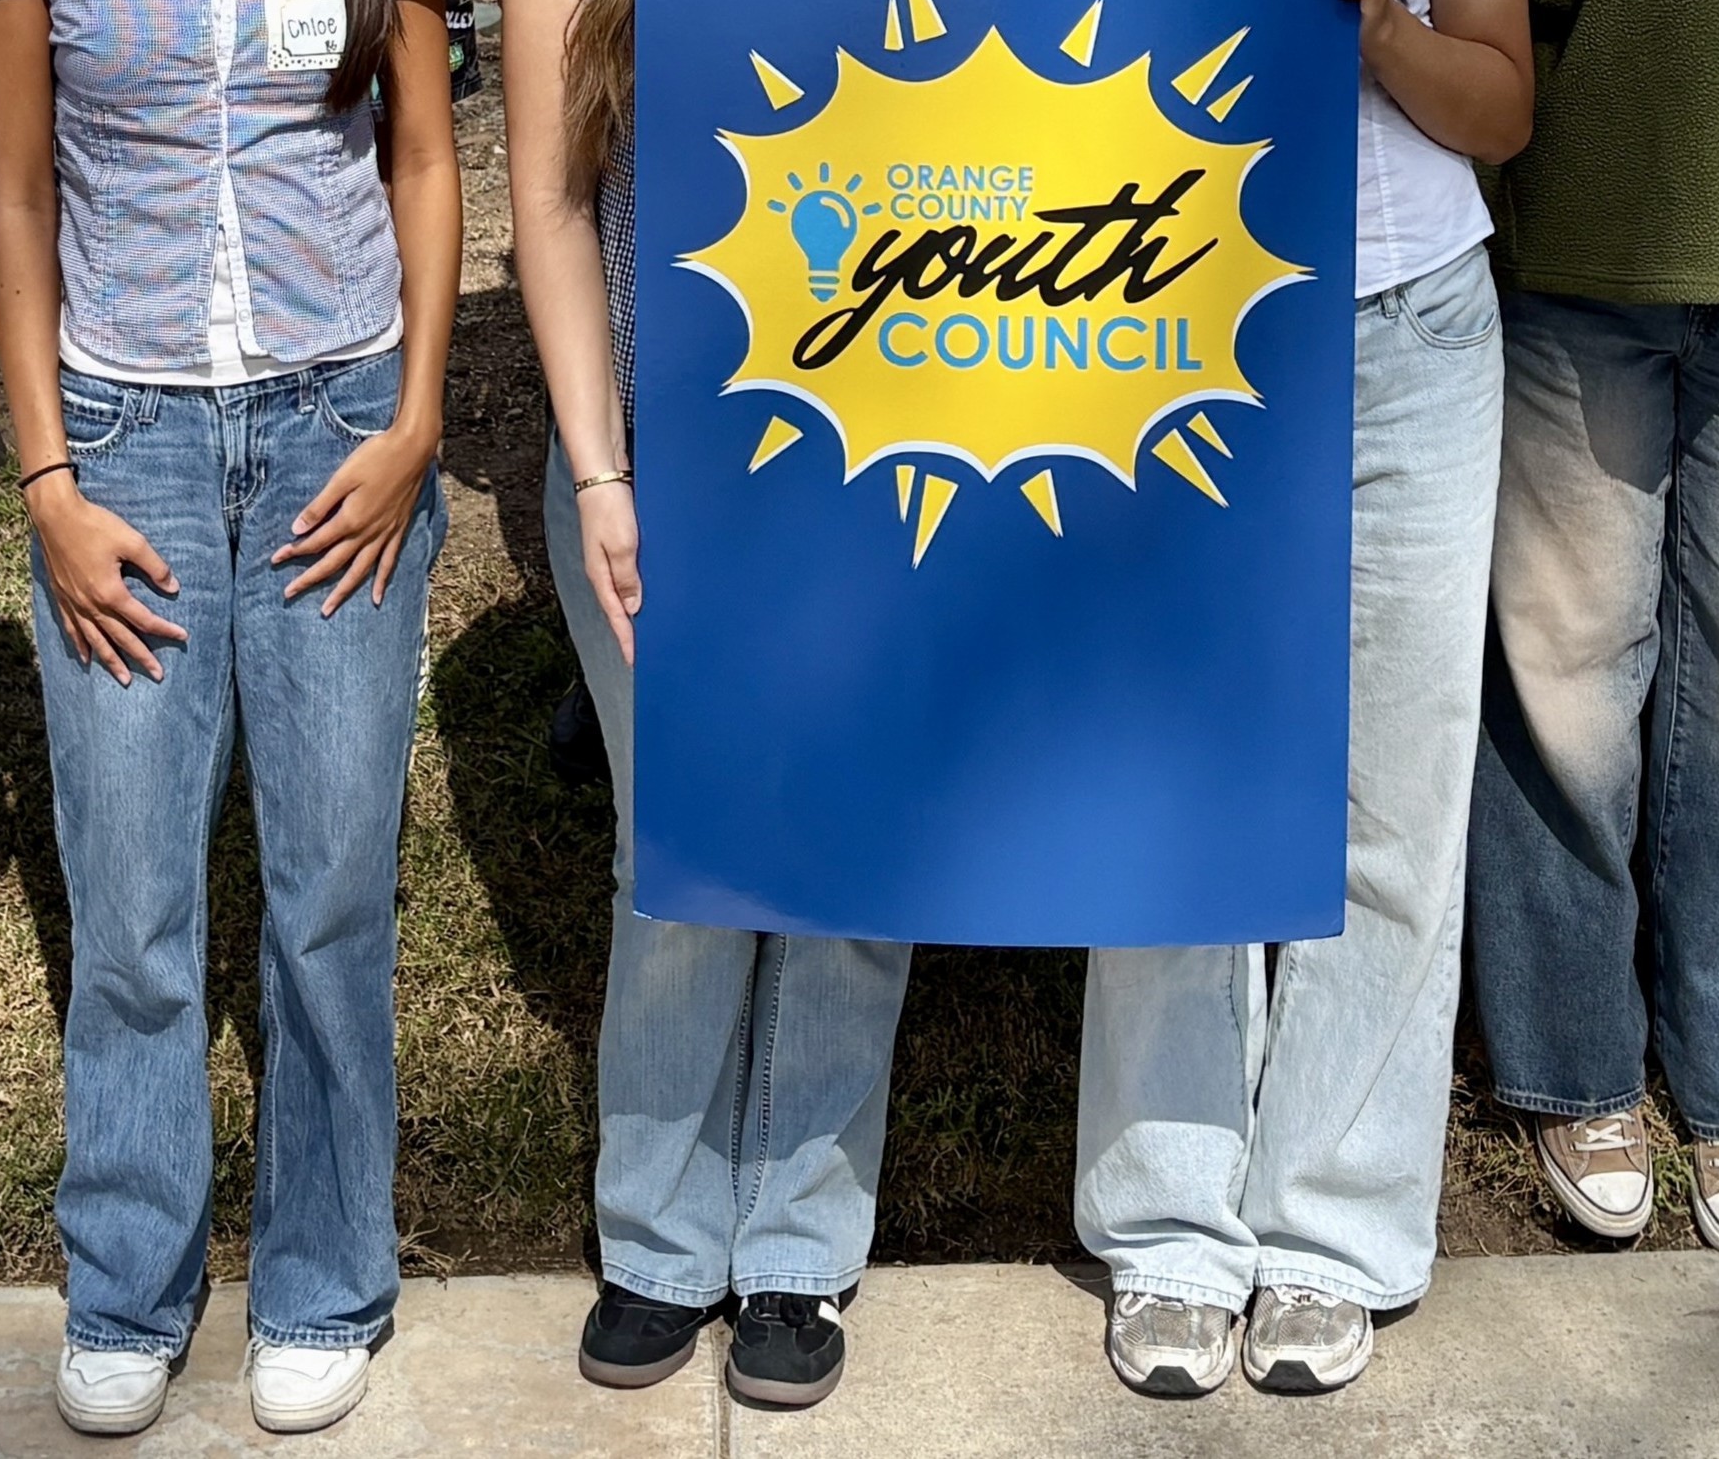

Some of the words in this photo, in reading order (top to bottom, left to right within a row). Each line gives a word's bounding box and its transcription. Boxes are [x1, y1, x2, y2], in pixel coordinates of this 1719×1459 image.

[287, 17, 338, 39] Chloe
[886, 163, 1035, 192] ORANGE
[889, 193, 1030, 222] COUNTY
[791, 167, 1219, 370] youth
[877, 311, 1203, 371] COUNCIL
